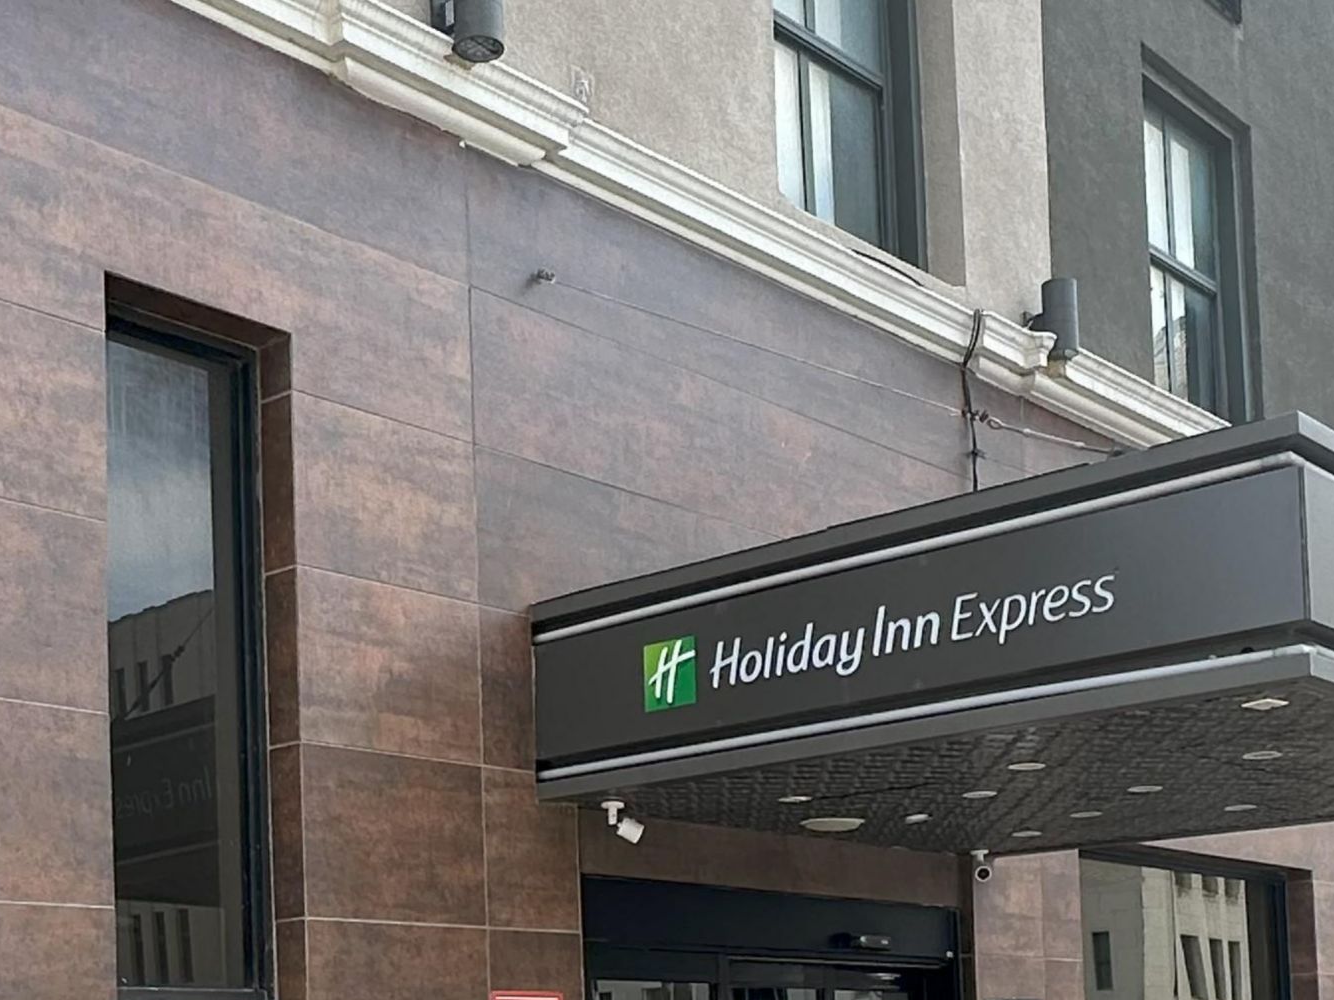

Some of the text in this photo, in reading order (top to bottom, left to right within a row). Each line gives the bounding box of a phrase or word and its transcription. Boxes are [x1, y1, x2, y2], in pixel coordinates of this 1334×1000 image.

[708, 574, 1116, 690] Holiday Inn Express
